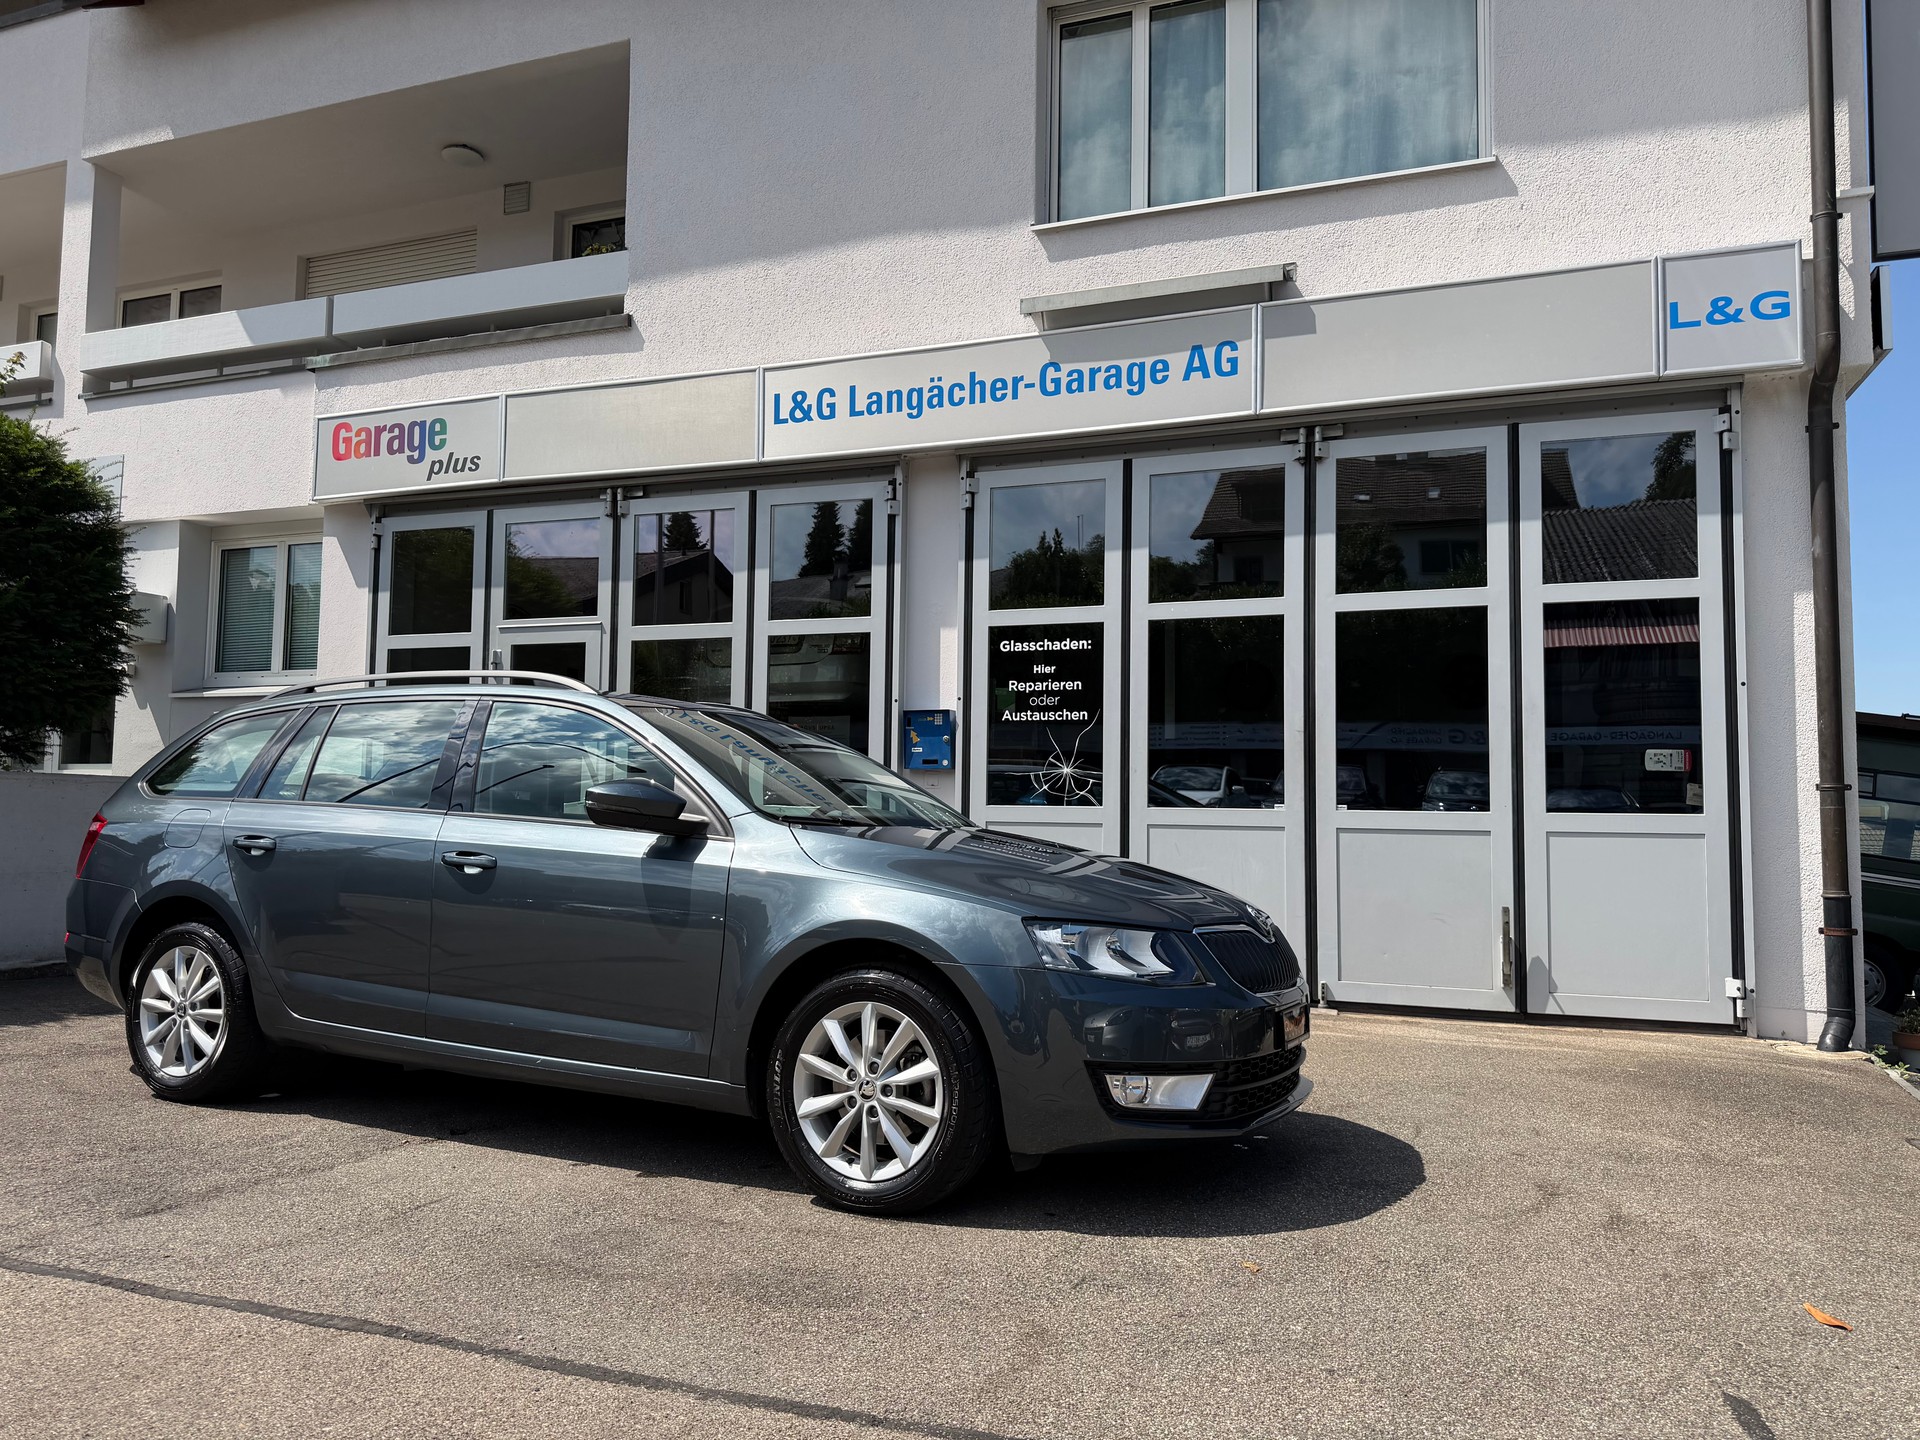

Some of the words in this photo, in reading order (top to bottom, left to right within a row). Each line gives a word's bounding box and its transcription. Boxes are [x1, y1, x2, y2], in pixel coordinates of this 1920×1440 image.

[1669, 290, 1791, 330] L&G
[773, 386, 837, 425] L&G
[848, 357, 1170, 420] Langächer-Garage
[1181, 339, 1240, 382] AG
[331, 416, 448, 465] Garage
[426, 451, 482, 481] plus
[999, 637, 1092, 652] Glasschaden:
[1033, 664, 1056, 674] Hier
[1008, 679, 1082, 693] Reparieren
[1029, 694, 1060, 706] oder
[1001, 709, 1088, 721] Austauschen
